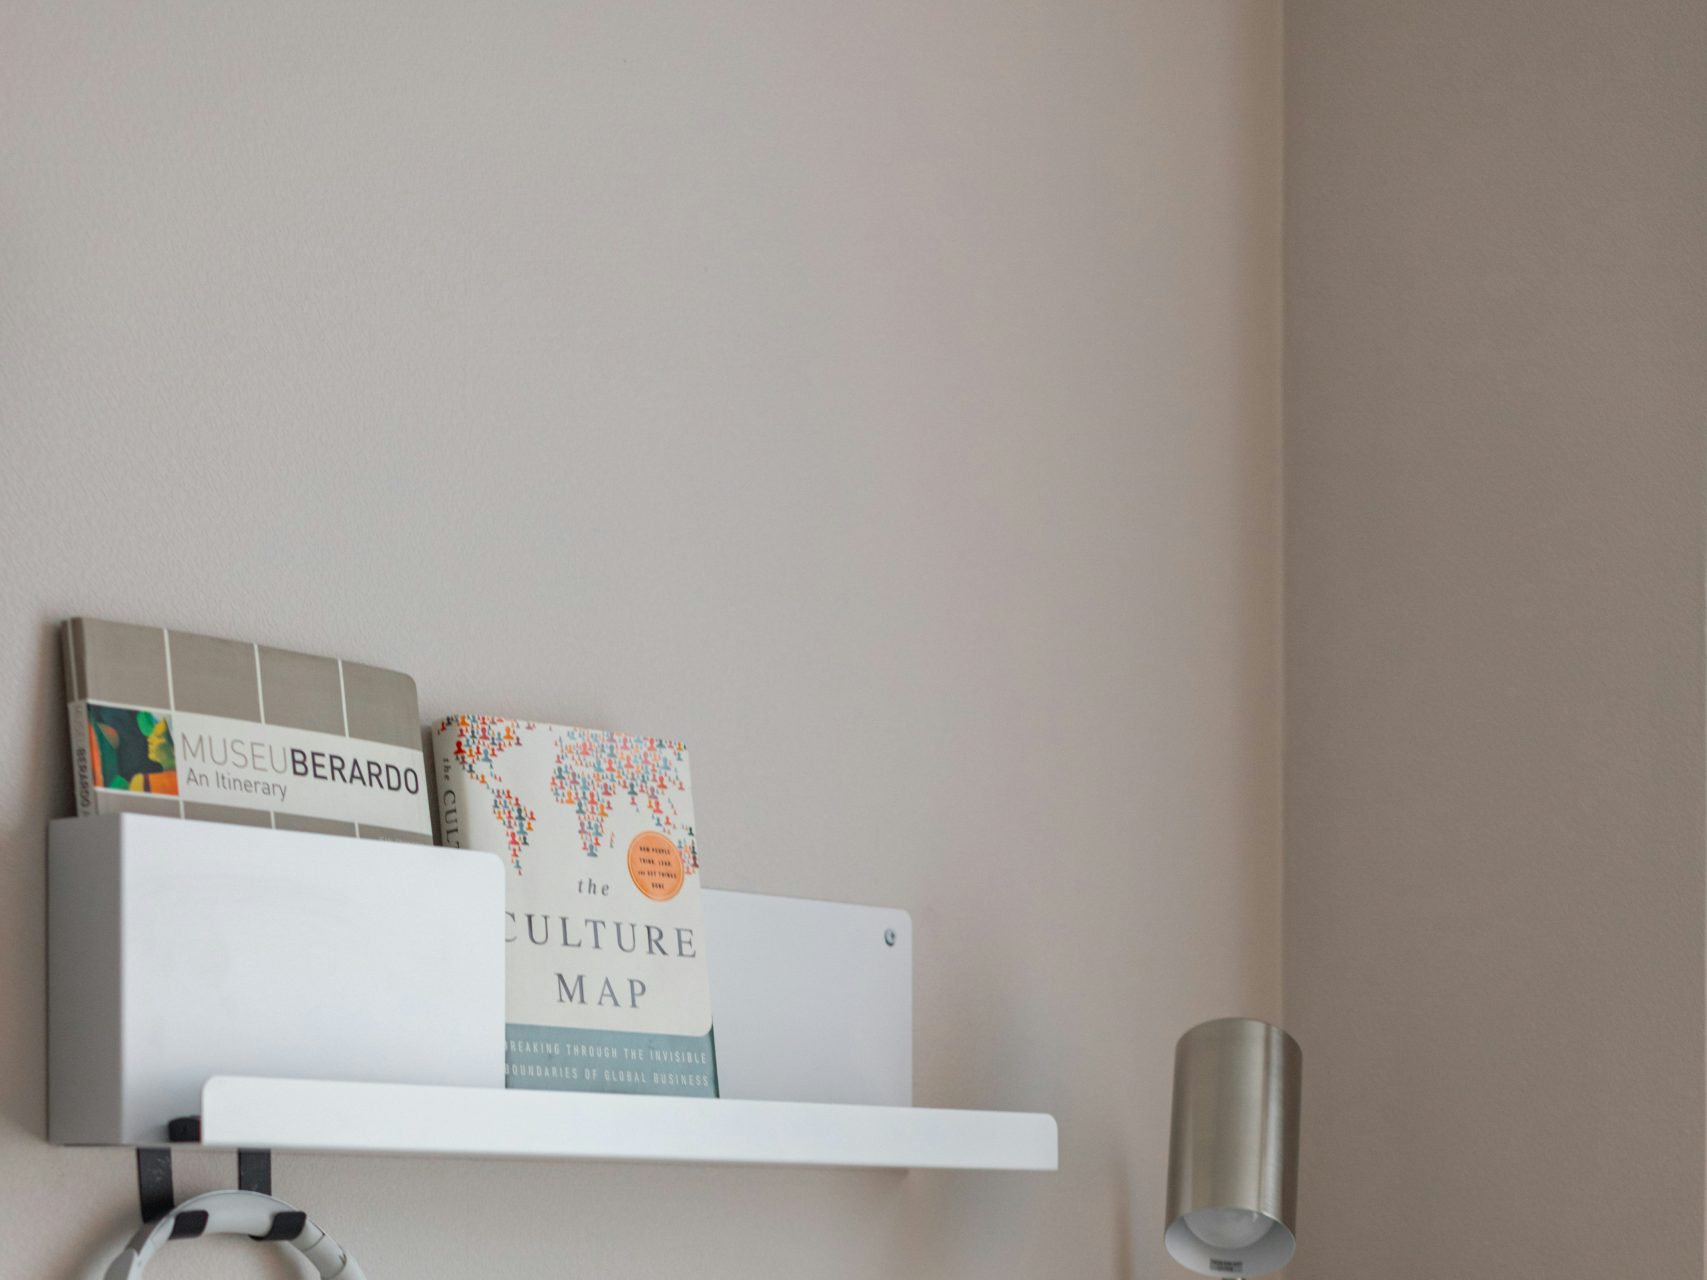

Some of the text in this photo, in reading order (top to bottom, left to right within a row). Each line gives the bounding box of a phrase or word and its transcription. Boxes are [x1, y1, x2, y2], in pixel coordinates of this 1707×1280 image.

[443, 758, 451, 780] the
[186, 767, 288, 802] An Itinerary
[577, 878, 610, 896] the
[554, 972, 647, 1009] MAP
[566, 1043, 617, 1058] THROUGH
[624, 1047, 643, 1060] THE
[650, 1049, 707, 1064] INVISIBLE
[585, 1068, 597, 1080] OF
[604, 1069, 646, 1083] GLOBAL
[653, 1072, 709, 1087] BUSINESS
